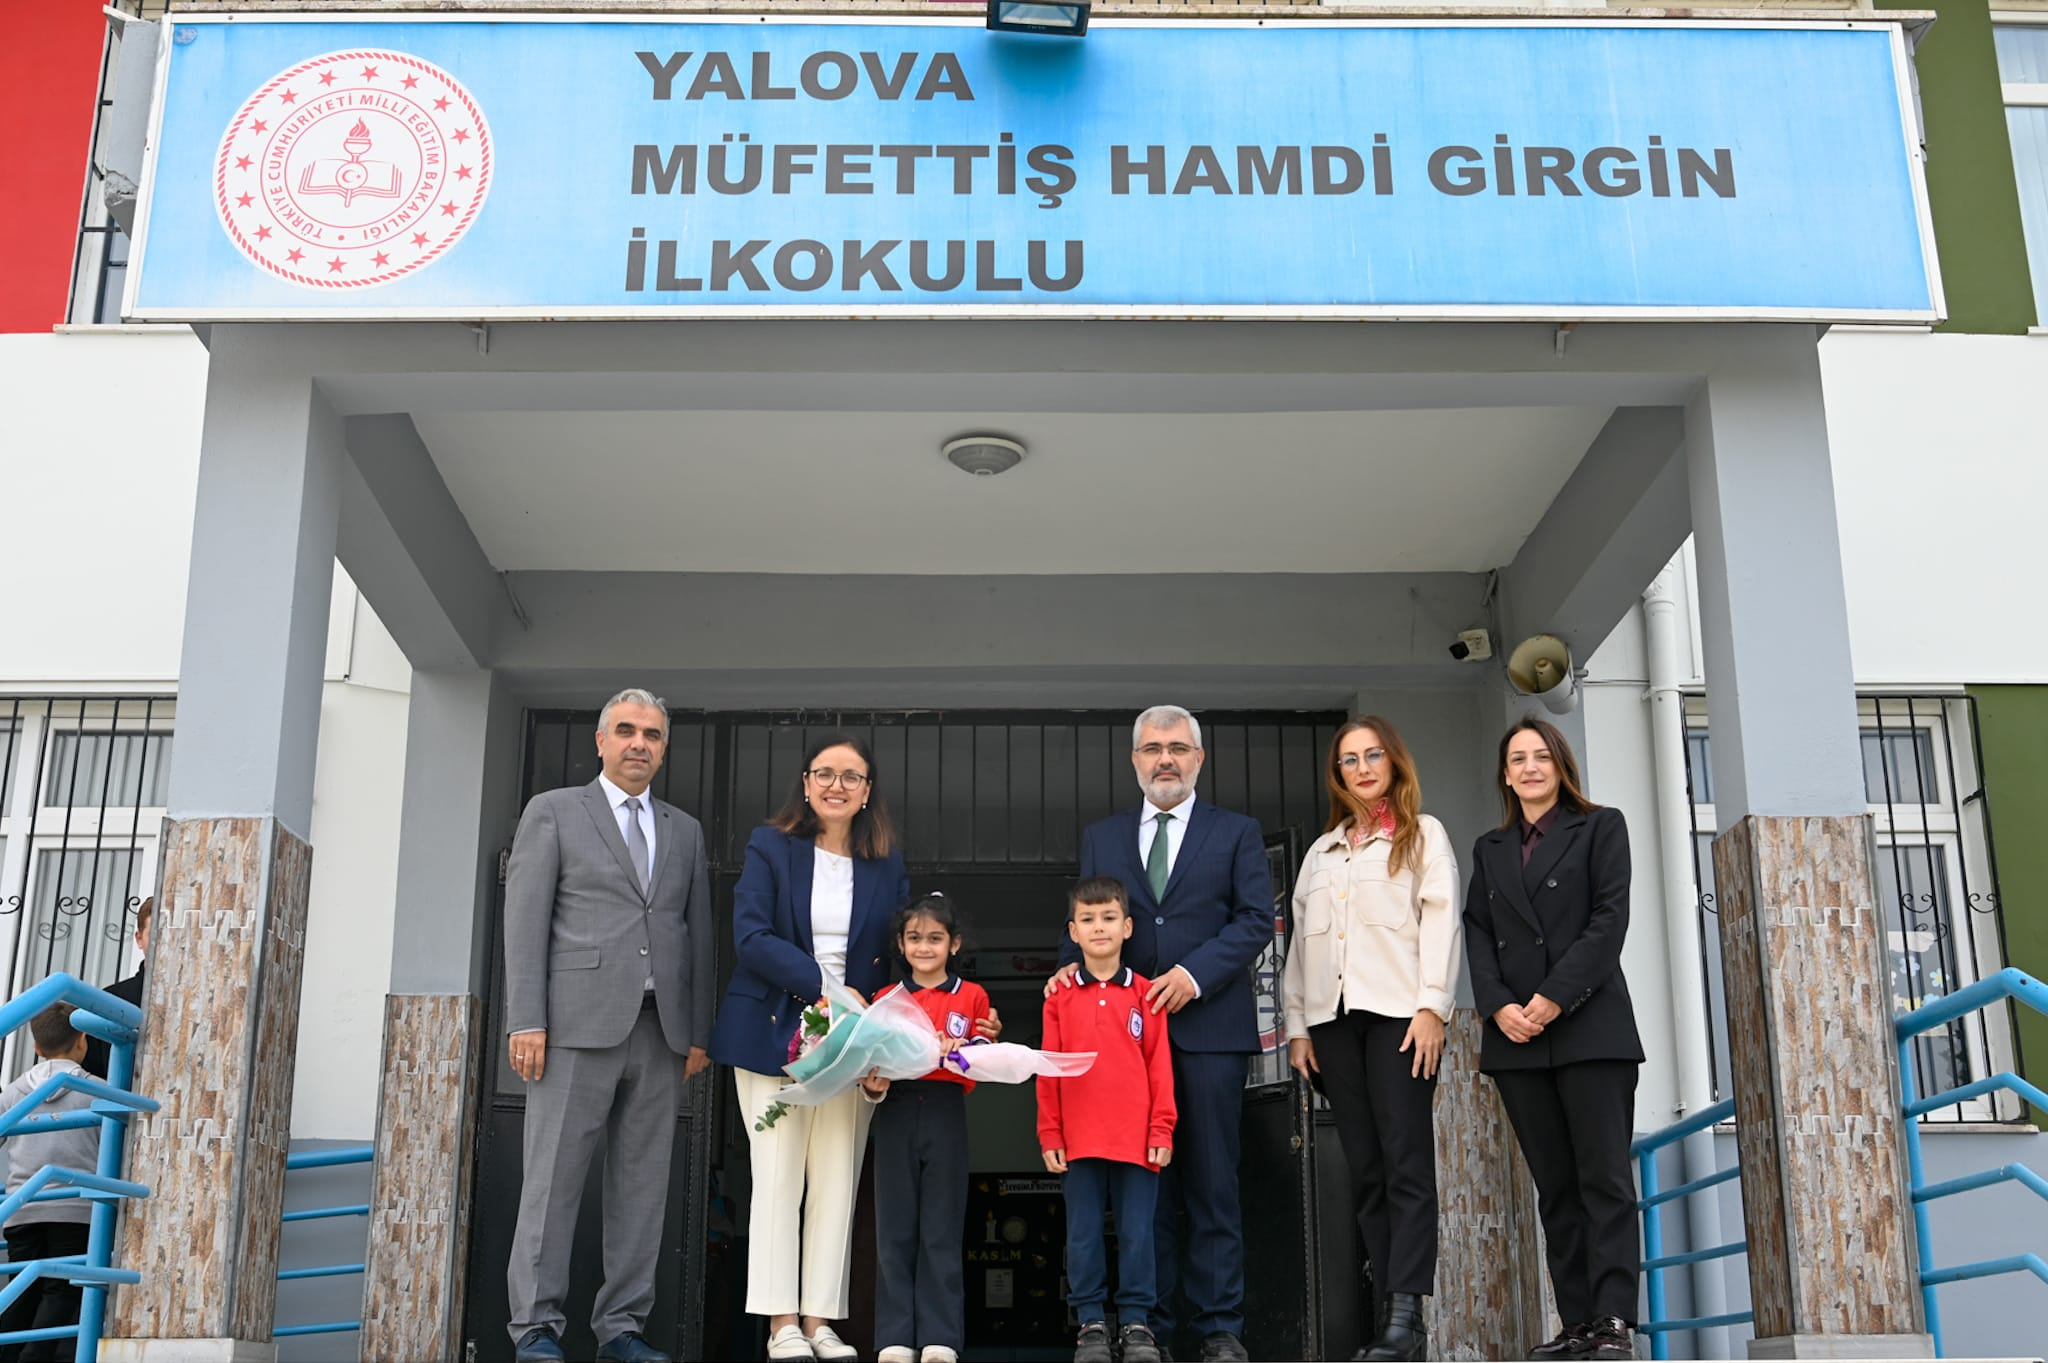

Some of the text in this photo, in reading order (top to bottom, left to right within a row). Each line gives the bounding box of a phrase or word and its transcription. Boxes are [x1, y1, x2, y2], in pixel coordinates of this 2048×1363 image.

[635, 51, 975, 101] YALOVA
[268, 93, 353, 181] CUMHURİYETİ
[407, 113, 440, 165] EĞİTİM
[630, 132, 1736, 209] MÜFETTİŞ HAMDİ GİRGİN
[269, 185, 323, 239] TÜRKİYE
[363, 170, 438, 241] BAKANLIĞI
[625, 227, 1084, 291] İLKOKULU
